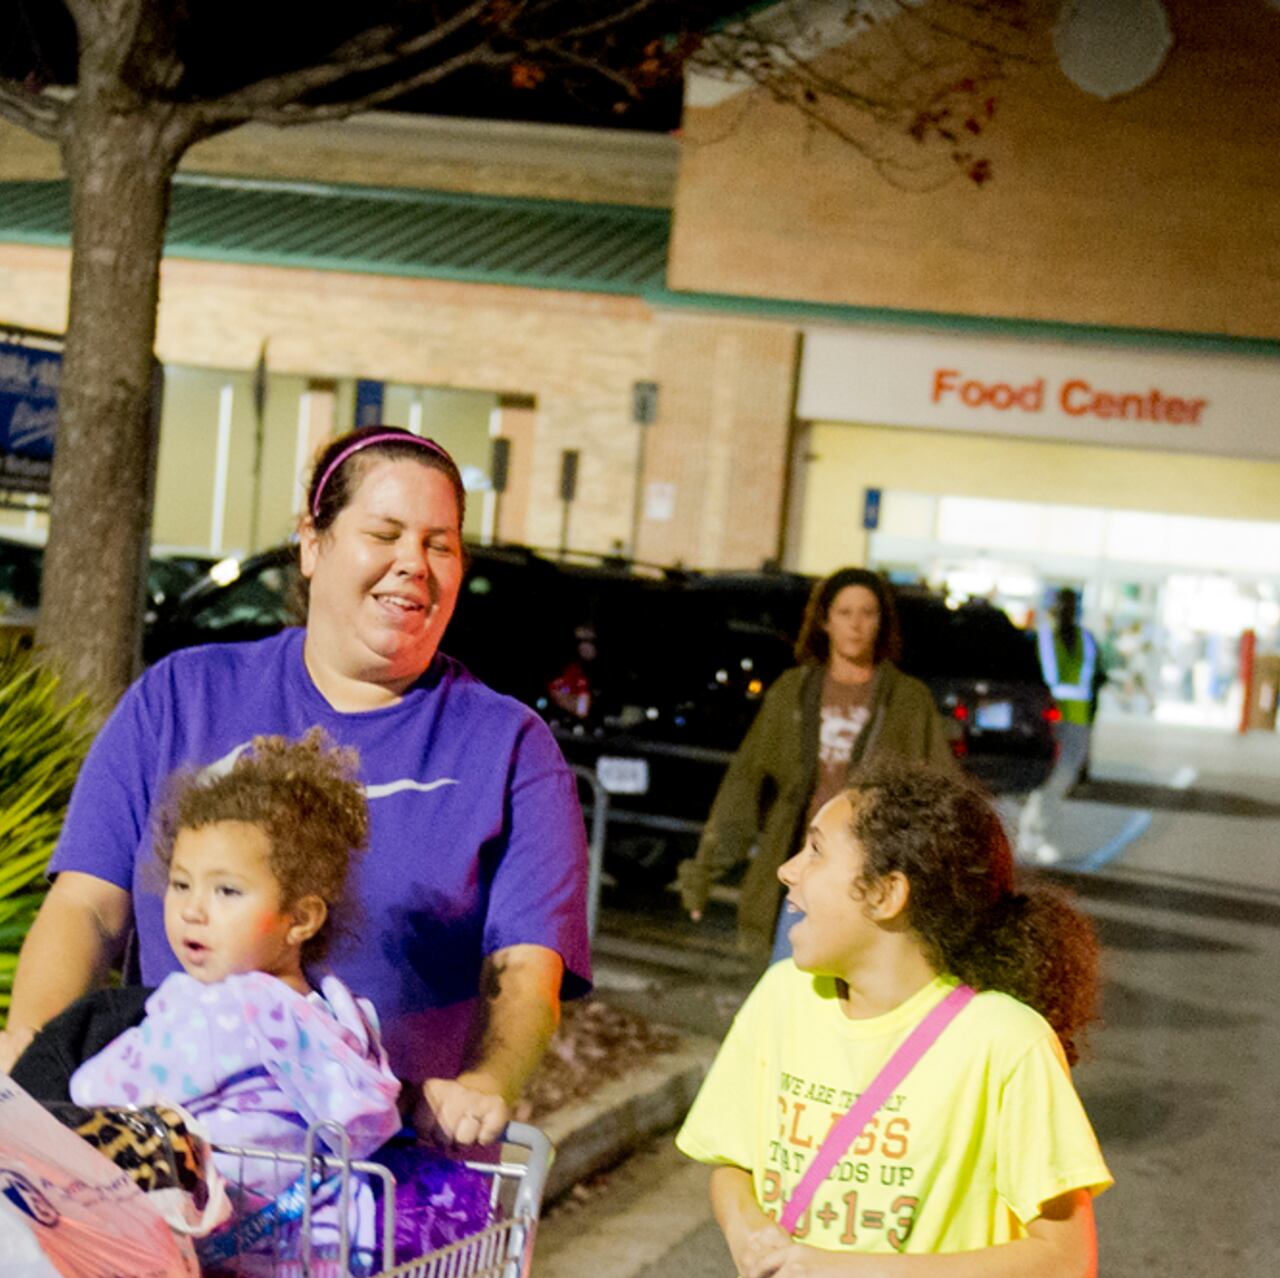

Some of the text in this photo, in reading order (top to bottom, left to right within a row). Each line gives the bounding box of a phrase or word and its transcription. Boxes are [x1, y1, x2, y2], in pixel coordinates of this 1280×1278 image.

[931, 368, 1206, 425] Food Center
[880, 1163, 915, 1188] UP
